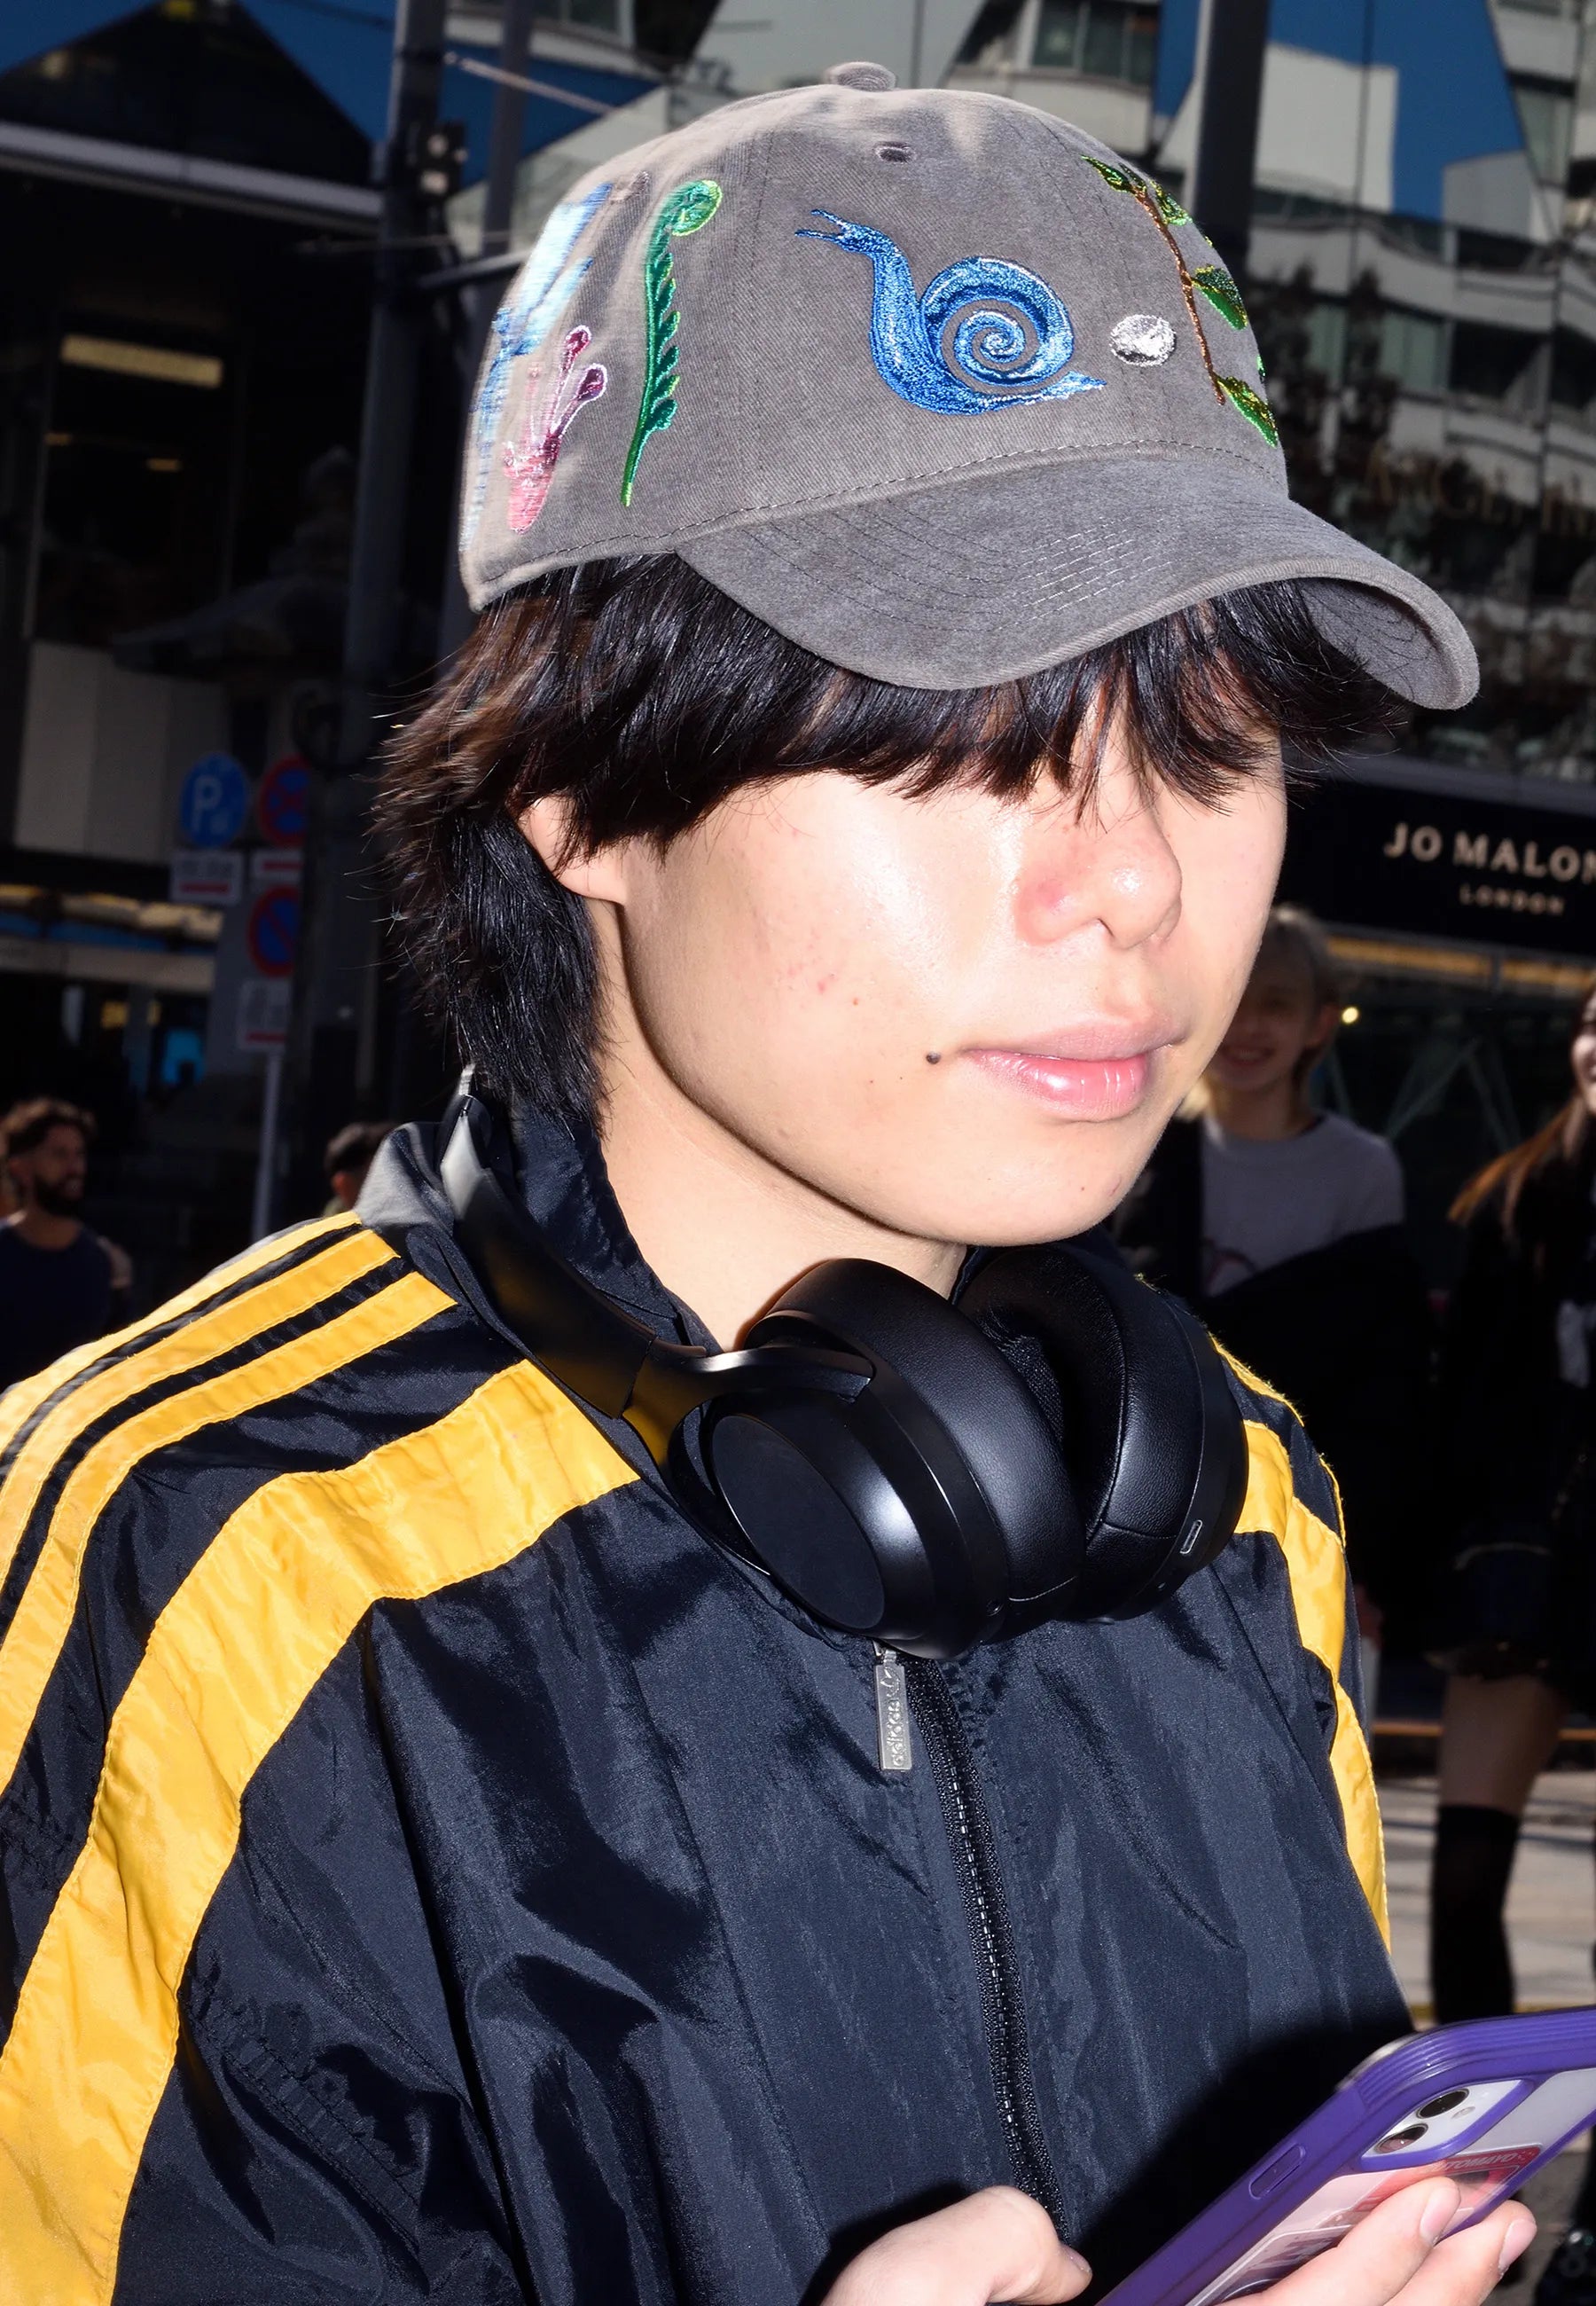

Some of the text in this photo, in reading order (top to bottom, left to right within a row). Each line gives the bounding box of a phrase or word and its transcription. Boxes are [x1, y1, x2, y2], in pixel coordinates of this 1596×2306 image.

[190, 773, 223, 834] P
[1382, 820, 1443, 863] JO
[1458, 882, 1567, 917] LONDON
[887, 1698, 904, 1767] adidas
